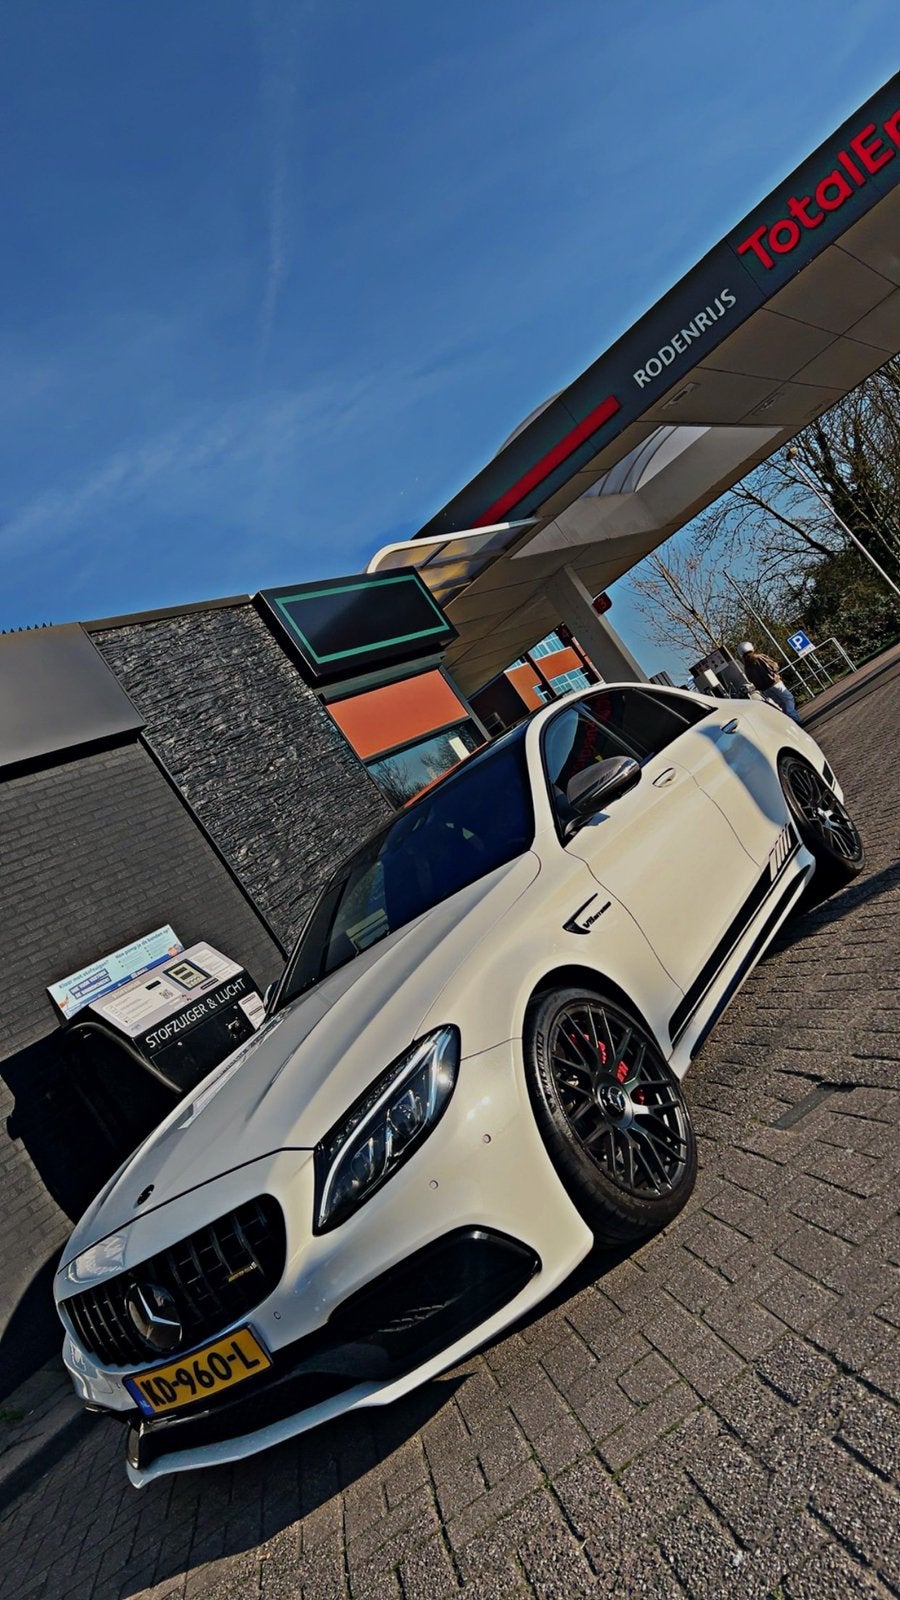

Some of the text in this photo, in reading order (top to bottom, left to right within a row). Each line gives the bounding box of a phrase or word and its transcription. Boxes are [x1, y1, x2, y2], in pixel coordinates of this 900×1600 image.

[633, 288, 737, 388] RODENRIJS
[792, 635, 803, 650] P
[145, 1003, 208, 1048] STOFZUIGER
[206, 998, 218, 1009] &
[215, 978, 246, 1003] LUCHT
[140, 1341, 261, 1406] KD-960-L
